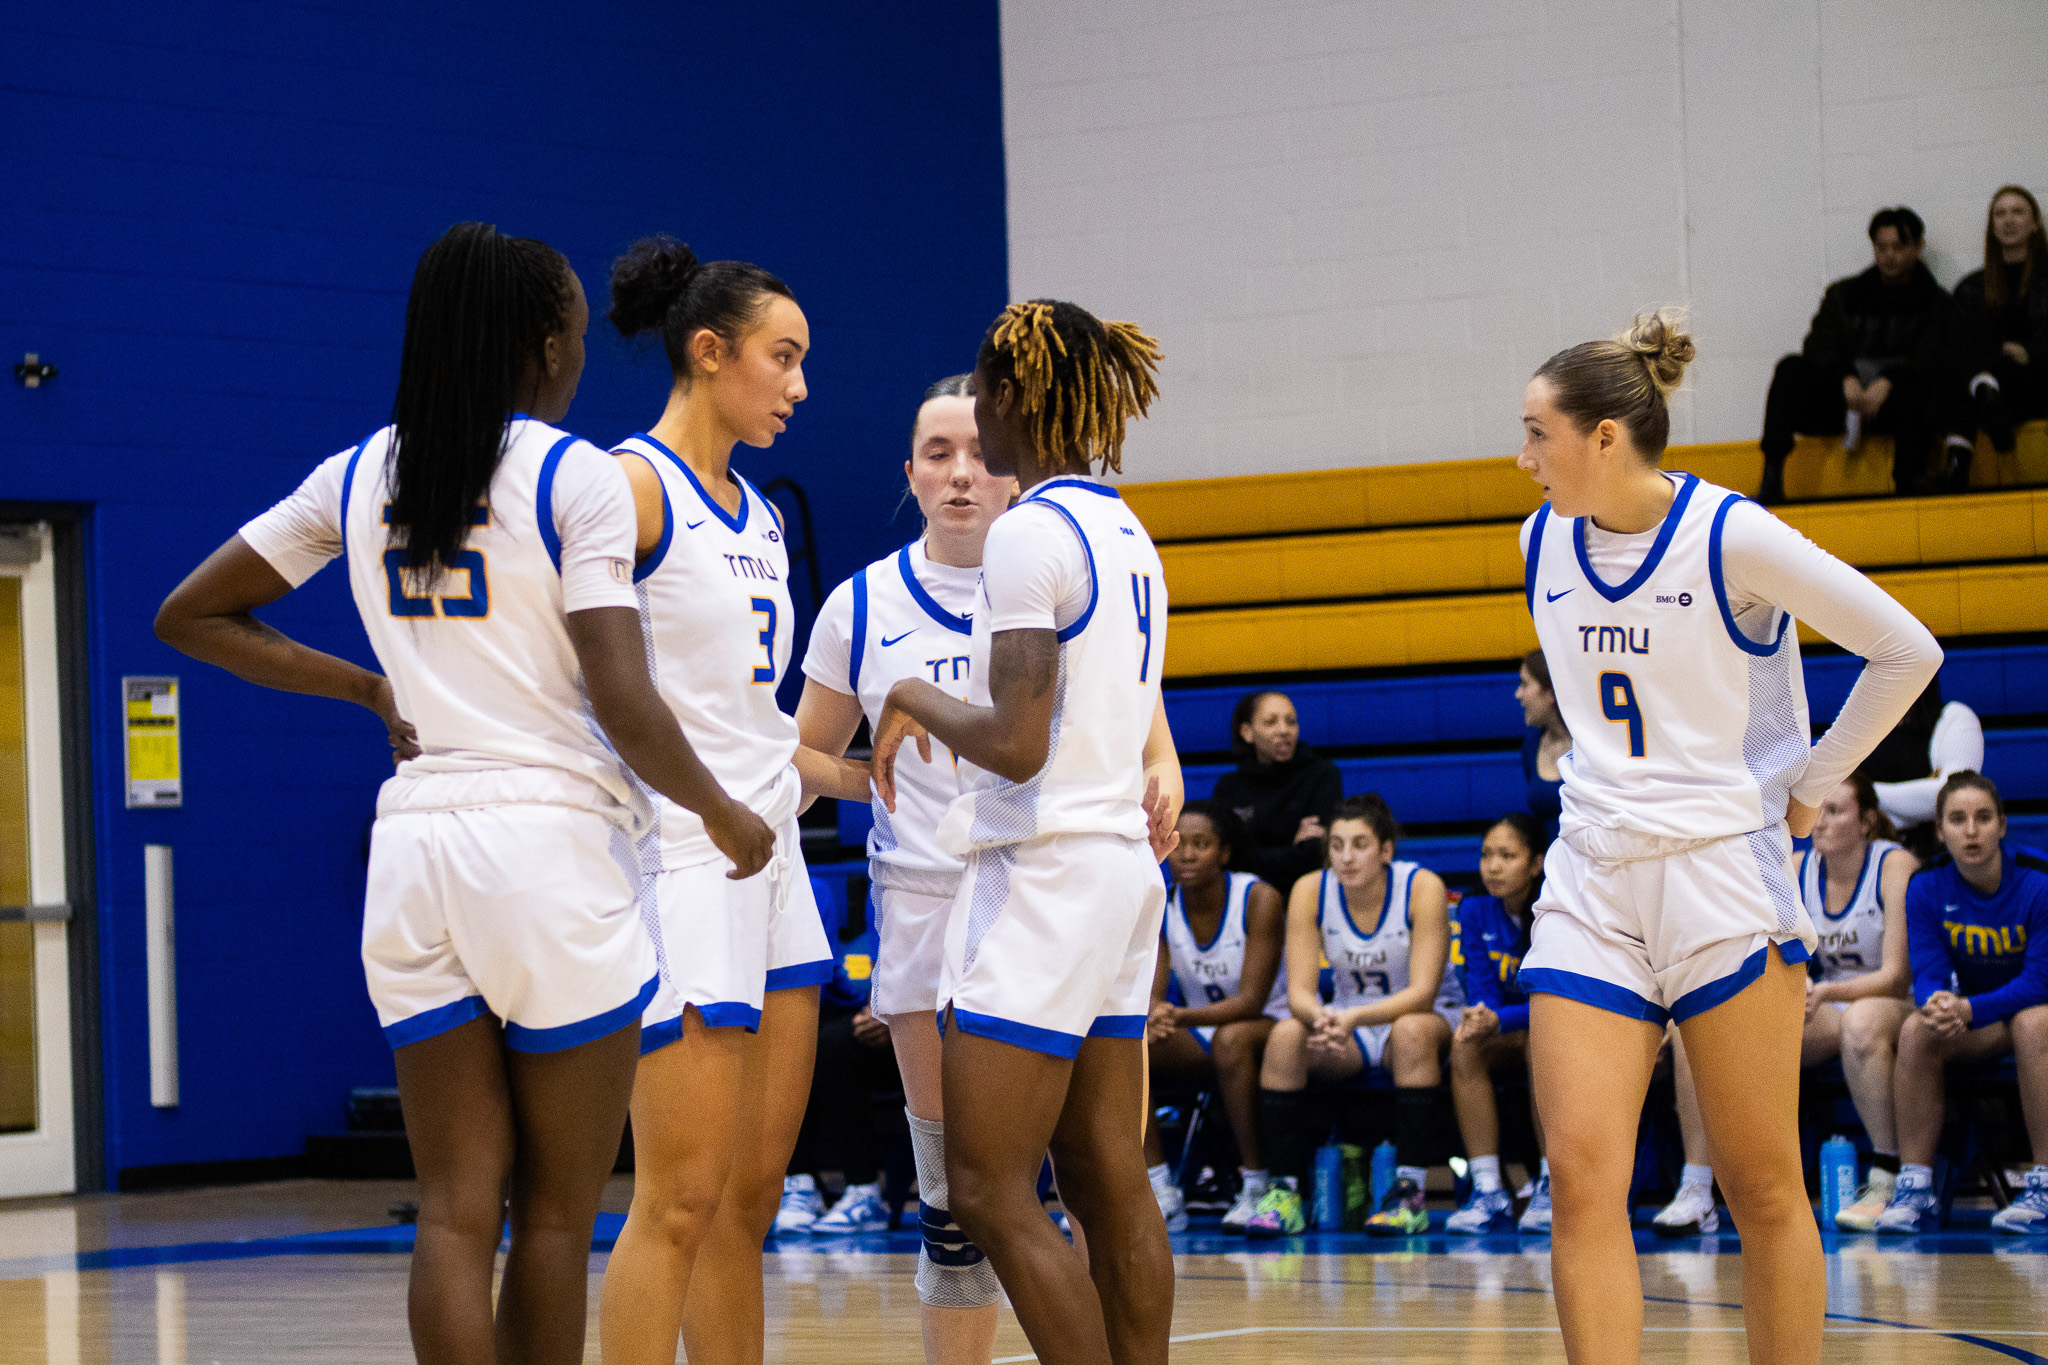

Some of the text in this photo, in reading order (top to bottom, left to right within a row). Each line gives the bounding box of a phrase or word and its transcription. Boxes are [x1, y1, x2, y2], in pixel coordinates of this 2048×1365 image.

[723, 552, 779, 582] TMU
[1655, 594, 1676, 604] BMO
[749, 594, 778, 686] 3
[1129, 570, 1151, 686] 4
[1578, 624, 1650, 656] TMU
[1597, 669, 1648, 760] 9
[1943, 920, 2027, 956] TMU
